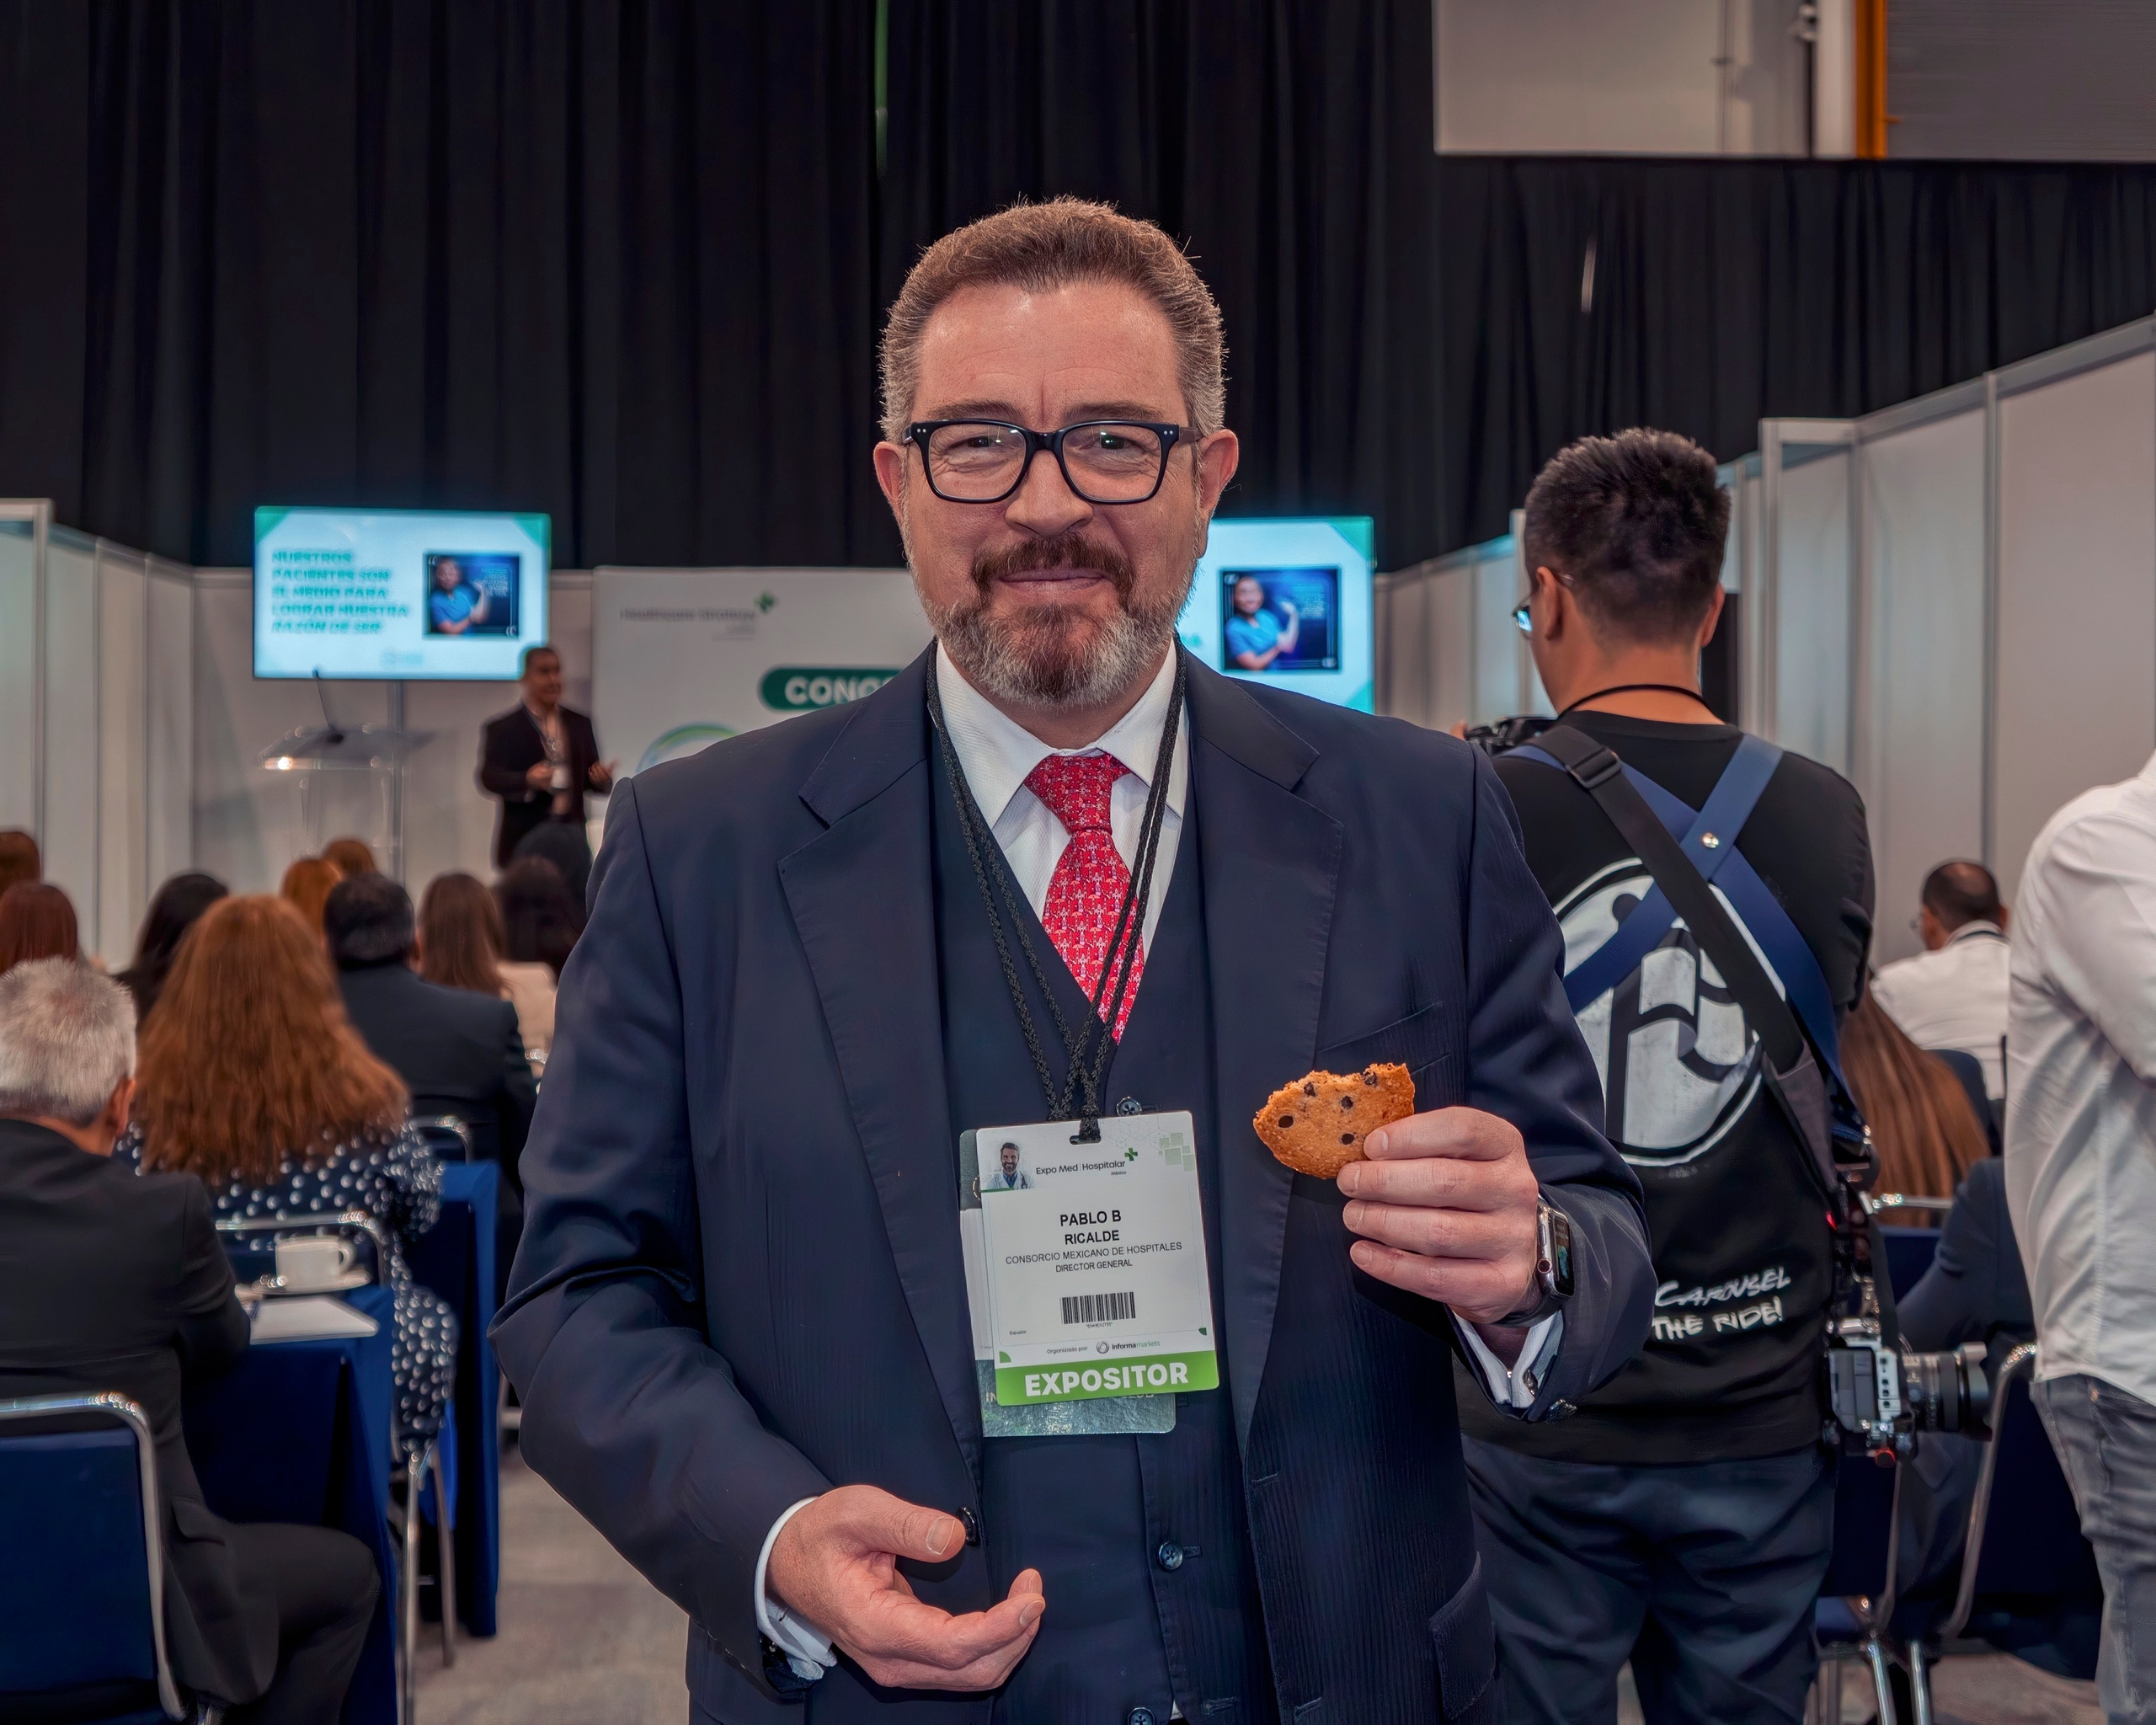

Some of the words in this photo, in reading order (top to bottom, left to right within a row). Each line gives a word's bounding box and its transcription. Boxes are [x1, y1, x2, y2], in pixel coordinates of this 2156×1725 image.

[1036, 1167, 1057, 1175] Expo
[1059, 1163, 1078, 1172] Med
[1082, 1161, 1125, 1171] Hospitalar
[1059, 1210, 1107, 1226] PABLO
[1112, 1210, 1122, 1222] B
[1065, 1230, 1120, 1245] RICALDE
[1006, 1252, 1060, 1264] CONSORCIO
[1063, 1247, 1110, 1260] MEXICANO
[1112, 1247, 1124, 1256] DE
[1126, 1242, 1182, 1254] HOSPITALES
[1055, 1263, 1095, 1273] DIRECTOR
[1097, 1259, 1133, 1269] GENERAL
[1652, 1315, 1704, 1340] THE
[1712, 1295, 1784, 1332] RIDE!
[1025, 1362, 1188, 1397] EXPOSITOR
